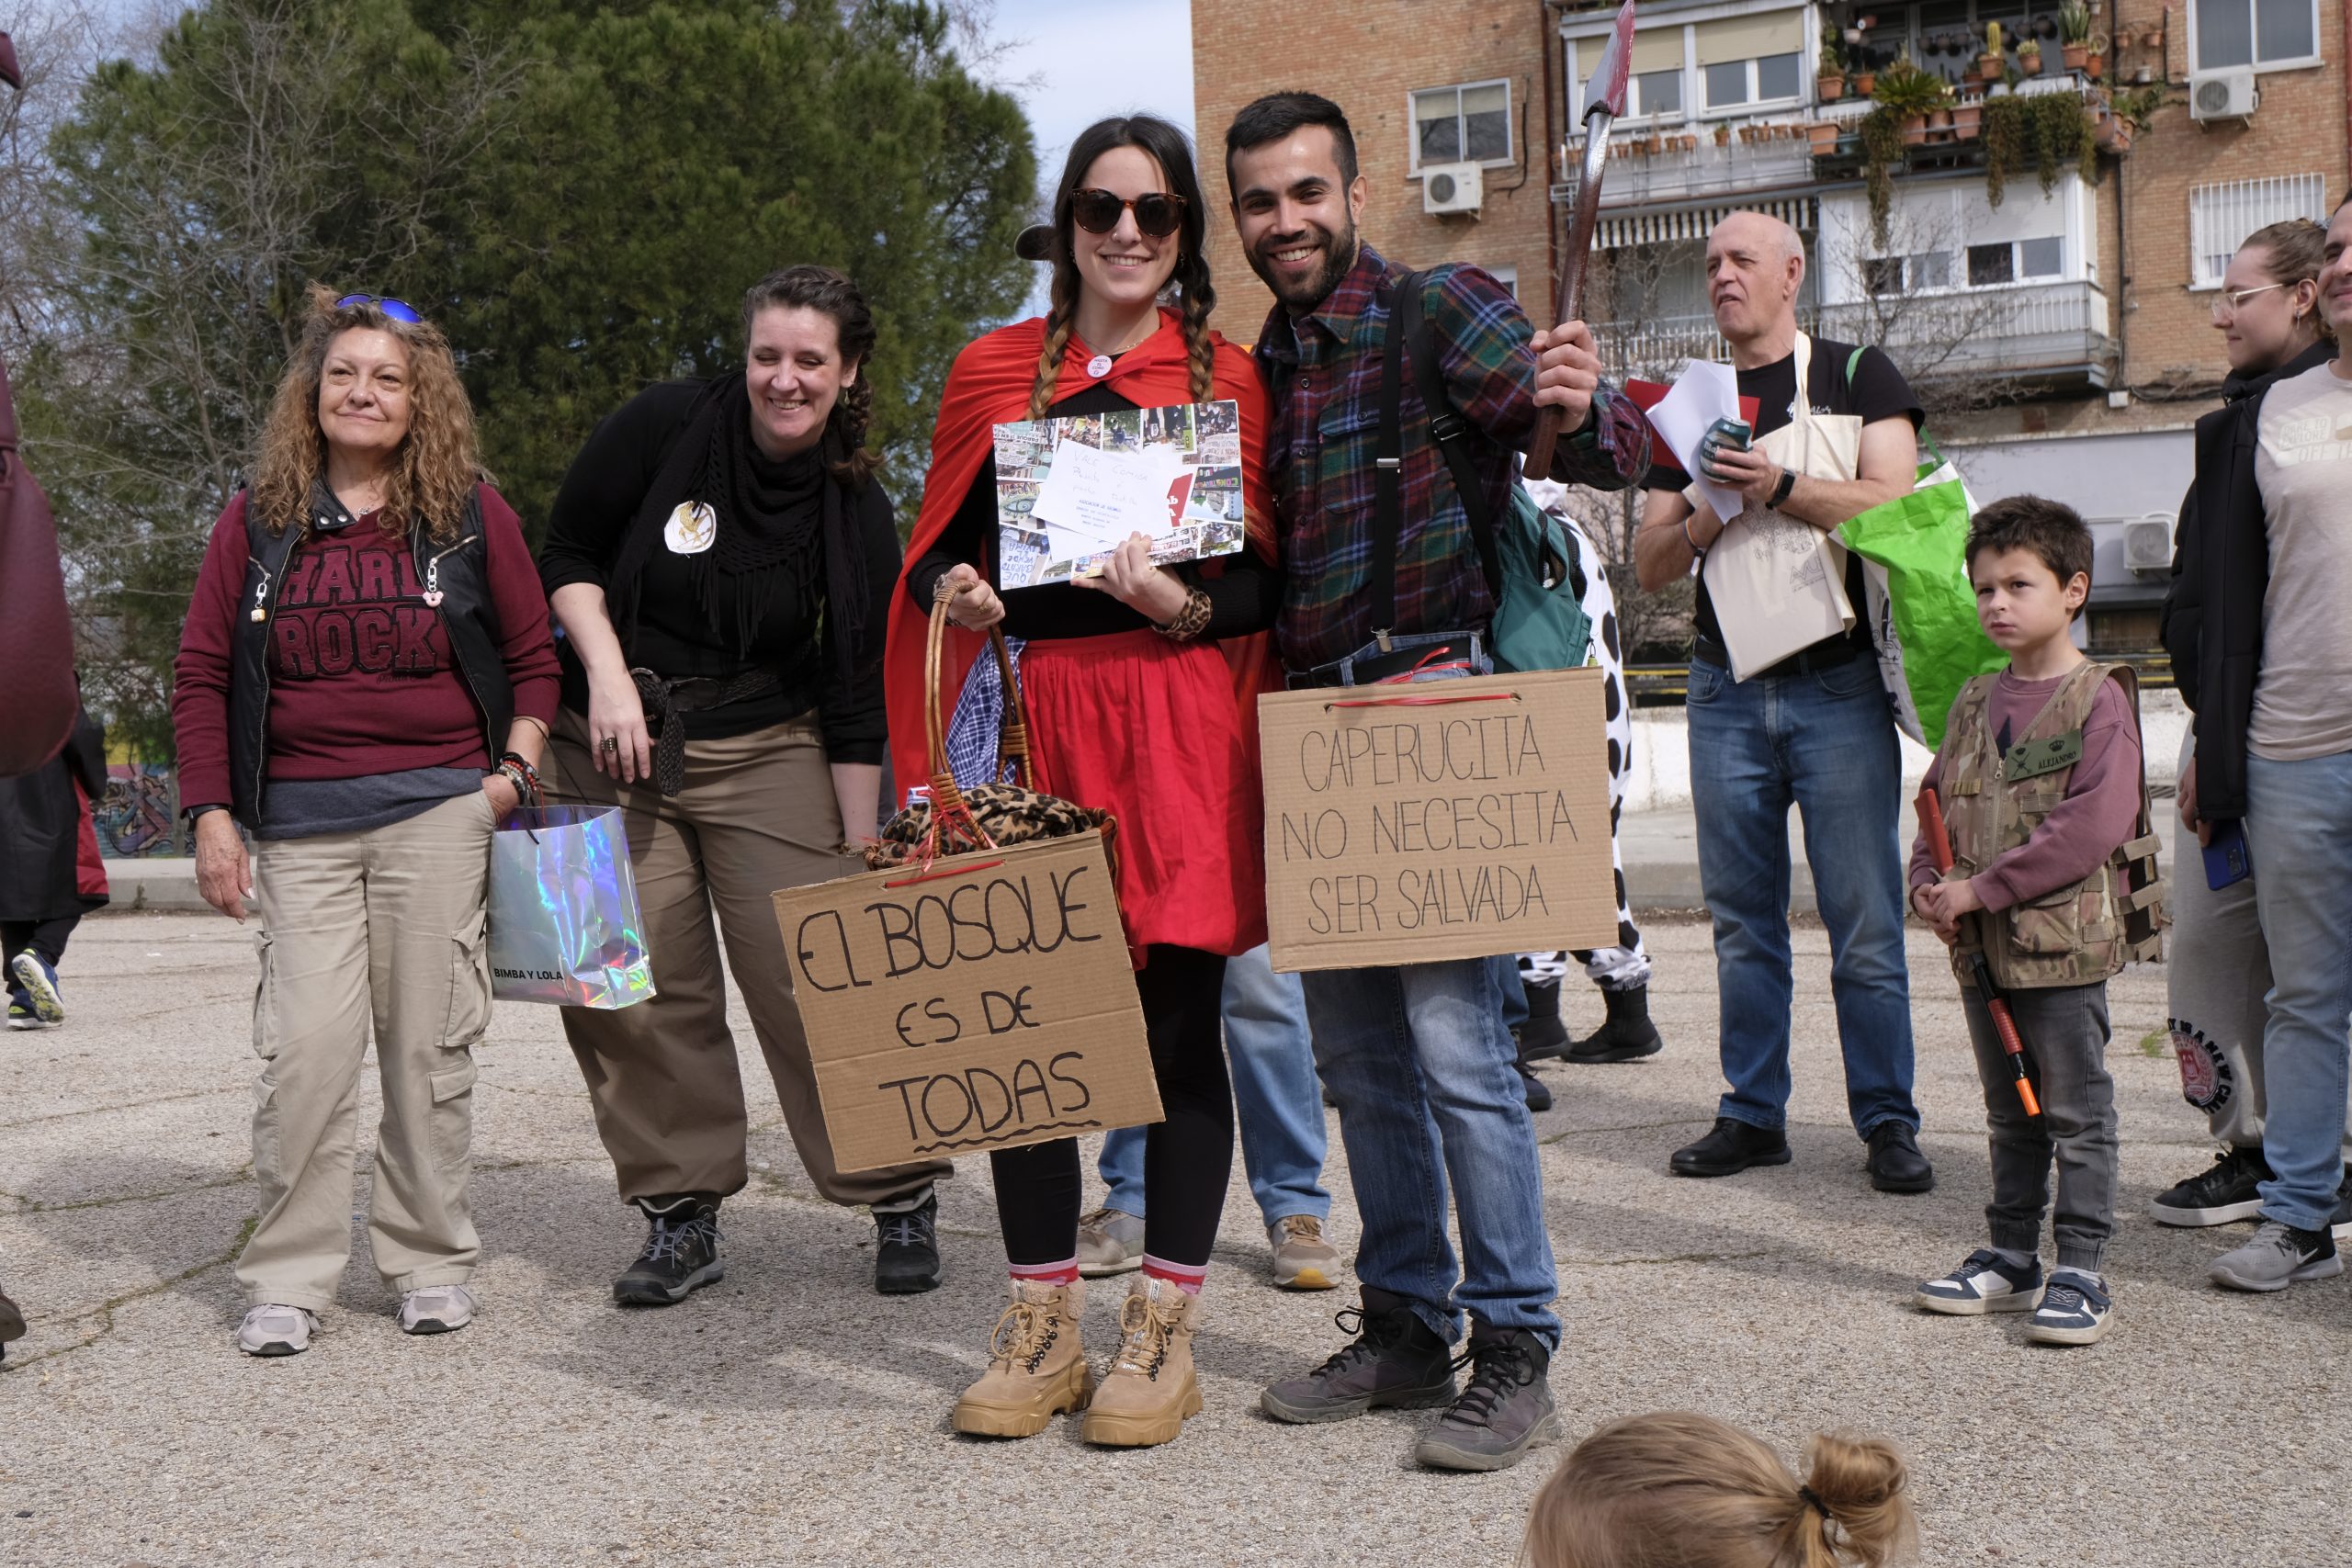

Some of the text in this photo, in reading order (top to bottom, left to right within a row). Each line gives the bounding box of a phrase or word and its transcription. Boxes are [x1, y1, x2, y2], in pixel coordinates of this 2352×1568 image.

[1001, 562, 1033, 573] BARATO
[1002, 571, 1027, 582] QUE
[1007, 555, 1034, 563] VENDE
[274, 609, 439, 681] ROCK
[1301, 715, 1545, 792] CAPERUCITA
[2038, 750, 2077, 770] ALEJANDRO
[1282, 790, 1578, 863] NO NECESITA
[797, 865, 1102, 992] EL BOSQUE
[1308, 864, 1549, 934] SER SALVADA
[493, 968, 563, 980] BIMBA Y LOLA
[895, 986, 1040, 1047] ES DE
[2194, 1030, 2204, 1043] A
[2204, 1040, 2233, 1082] NEW
[877, 1051, 1091, 1141] TODAS
